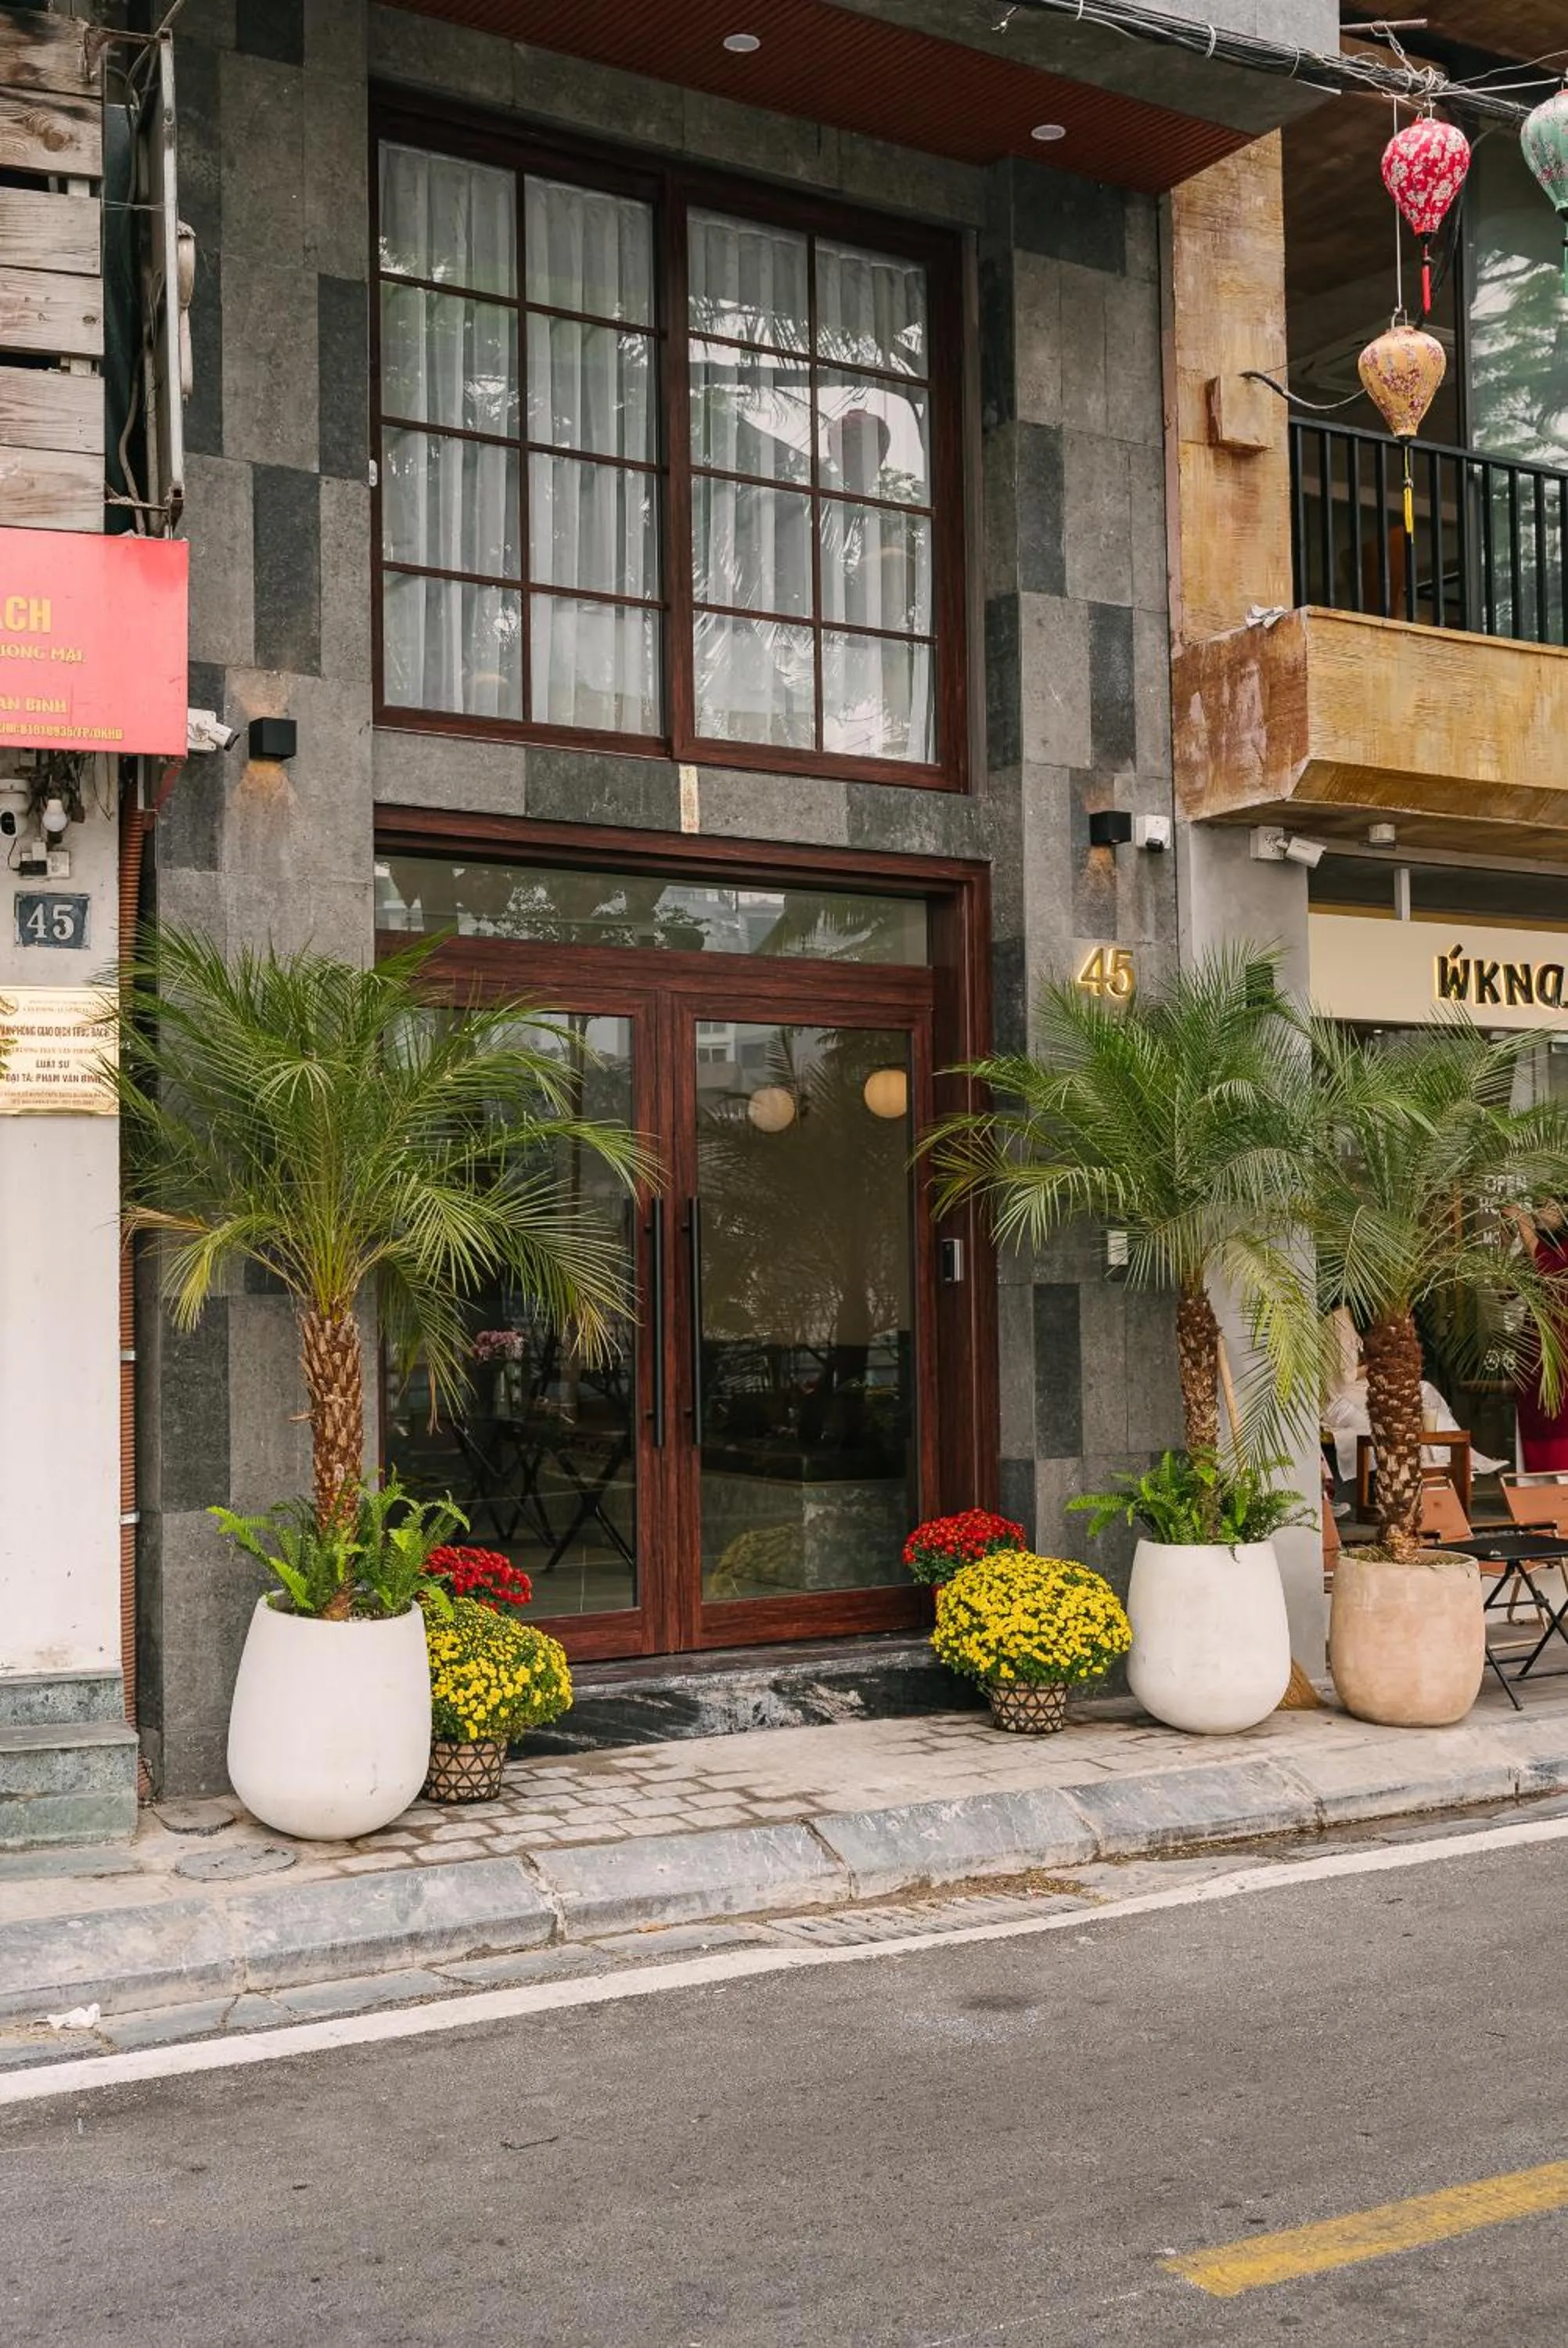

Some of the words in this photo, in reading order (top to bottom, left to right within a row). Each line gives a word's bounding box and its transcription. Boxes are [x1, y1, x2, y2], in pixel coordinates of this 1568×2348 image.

[0, 596, 51, 633] CH
[27, 902, 74, 940] 45
[1077, 947, 1135, 998] 45
